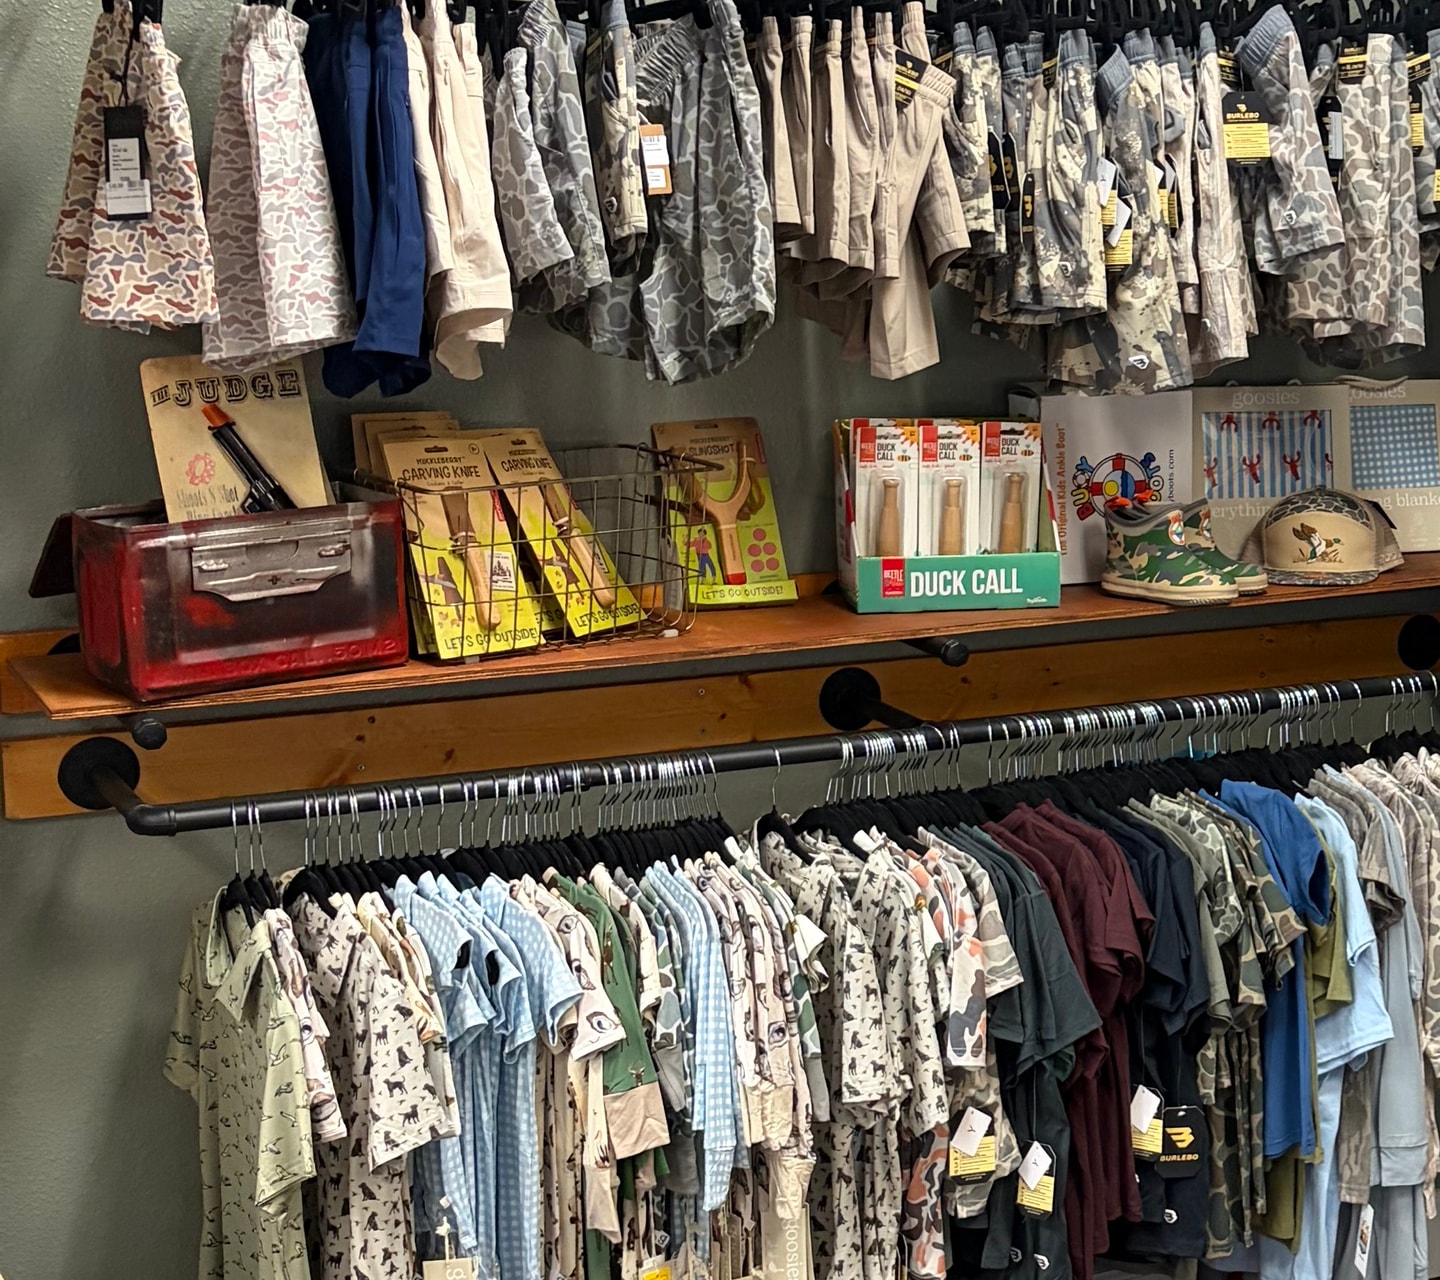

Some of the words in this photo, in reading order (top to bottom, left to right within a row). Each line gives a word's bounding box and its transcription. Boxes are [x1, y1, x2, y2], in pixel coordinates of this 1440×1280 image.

[1226, 112, 1260, 120] BURLEBO
[150, 384, 171, 407] THE
[173, 369, 302, 407] JUDGE
[1231, 387, 1300, 408] goosies
[876, 442, 896, 452] DUCK
[938, 441, 958, 451] DUCK
[1001, 437, 1020, 447] DUCK
[688, 443, 736, 457] SLINGSHOT
[876, 451, 895, 461] CALL
[938, 450, 956, 461] CALL
[1001, 446, 1018, 456] CALL
[501, 458, 532, 472] CARVING
[532, 457, 552, 470] KNIFE
[1056, 453, 1066, 477] Ankle
[402, 466, 451, 482] CARVING
[451, 464, 481, 479] KNIFE
[1056, 478, 1066, 501] Kids
[1057, 501, 1067, 537] Original
[883, 569, 904, 583] BEETLE
[909, 569, 967, 598] DUCK
[971, 567, 1024, 596] CALL
[702, 589, 726, 600] LET'S
[728, 587, 742, 597] GO
[744, 585, 784, 597] OUTSIDE!
[574, 611, 600, 629] LET'S
[444, 635, 475, 651] LET'S
[475, 631, 490, 647] GO
[493, 626, 540, 644] OUTSIDE!
[1159, 1153, 1199, 1163] BURLEBO
